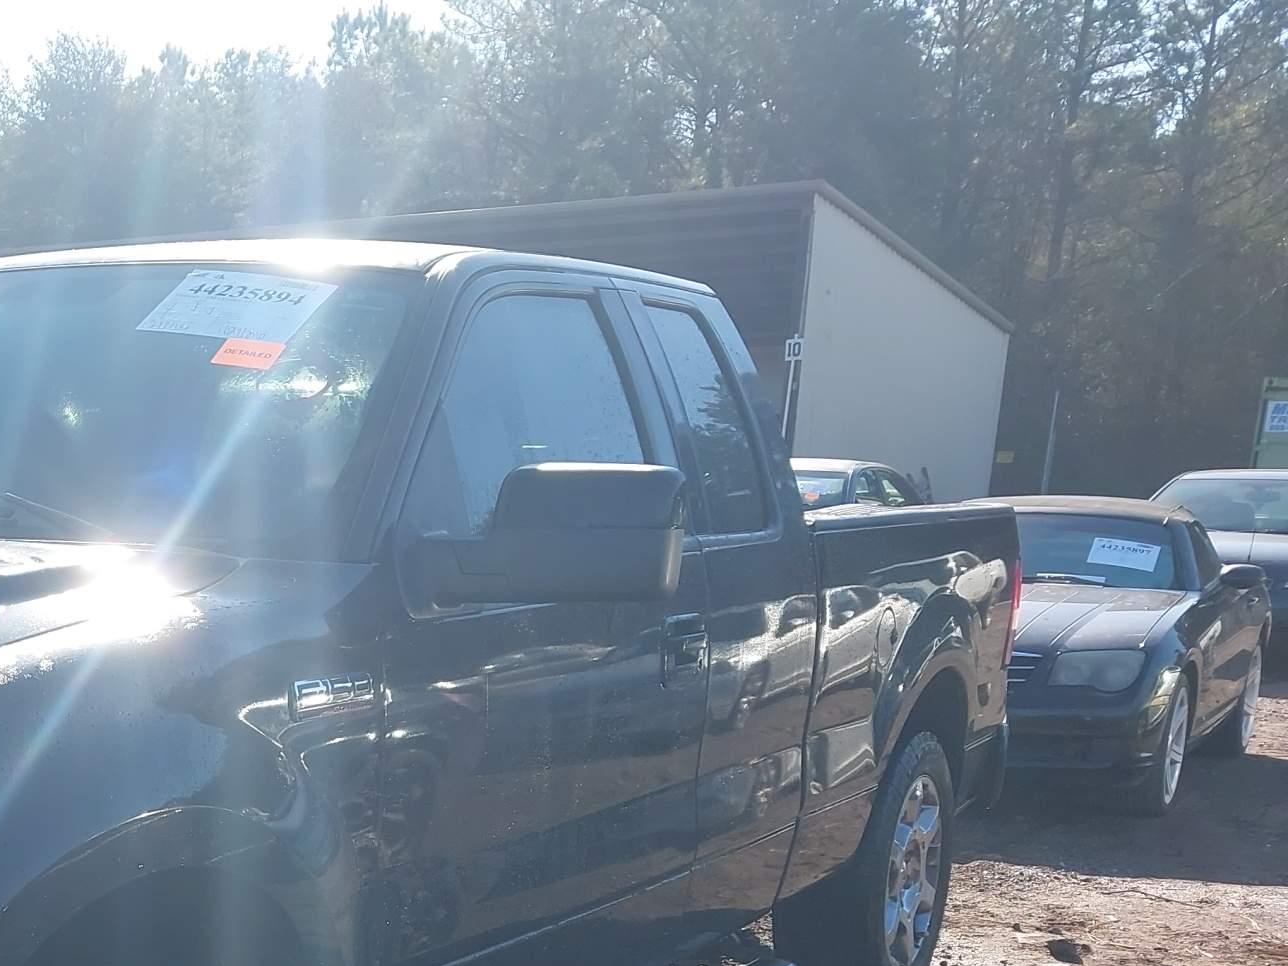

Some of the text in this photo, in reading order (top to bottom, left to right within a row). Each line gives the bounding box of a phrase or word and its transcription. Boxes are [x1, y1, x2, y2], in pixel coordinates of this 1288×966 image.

[189, 283, 307, 305] 44235894
[223, 347, 272, 360] DETAILED
[787, 342, 802, 357] 10
